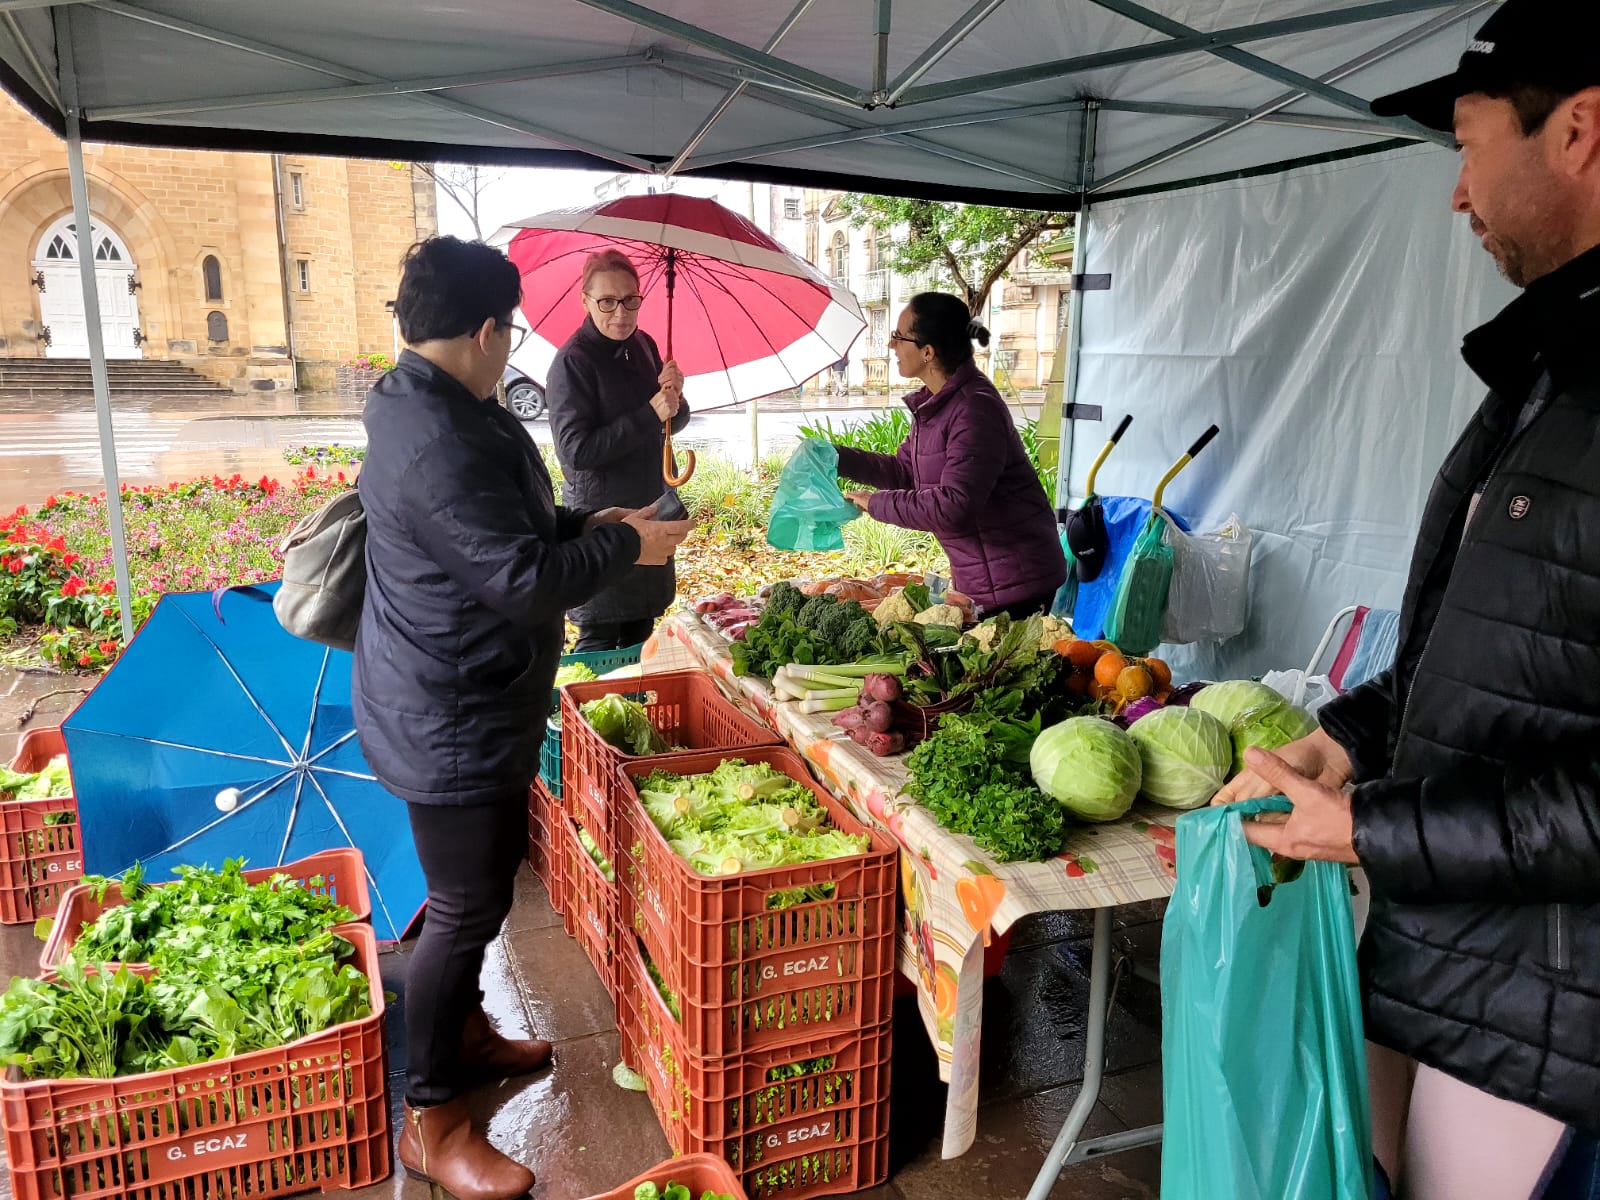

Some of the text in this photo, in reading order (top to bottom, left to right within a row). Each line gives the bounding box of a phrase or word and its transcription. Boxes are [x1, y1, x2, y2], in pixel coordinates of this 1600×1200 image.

[48, 860, 82, 872] G. EC
[763, 956, 829, 979] G. ECAZ
[167, 1133, 247, 1161] G. ECAZ
[766, 1122, 831, 1148] G. ECAZ
